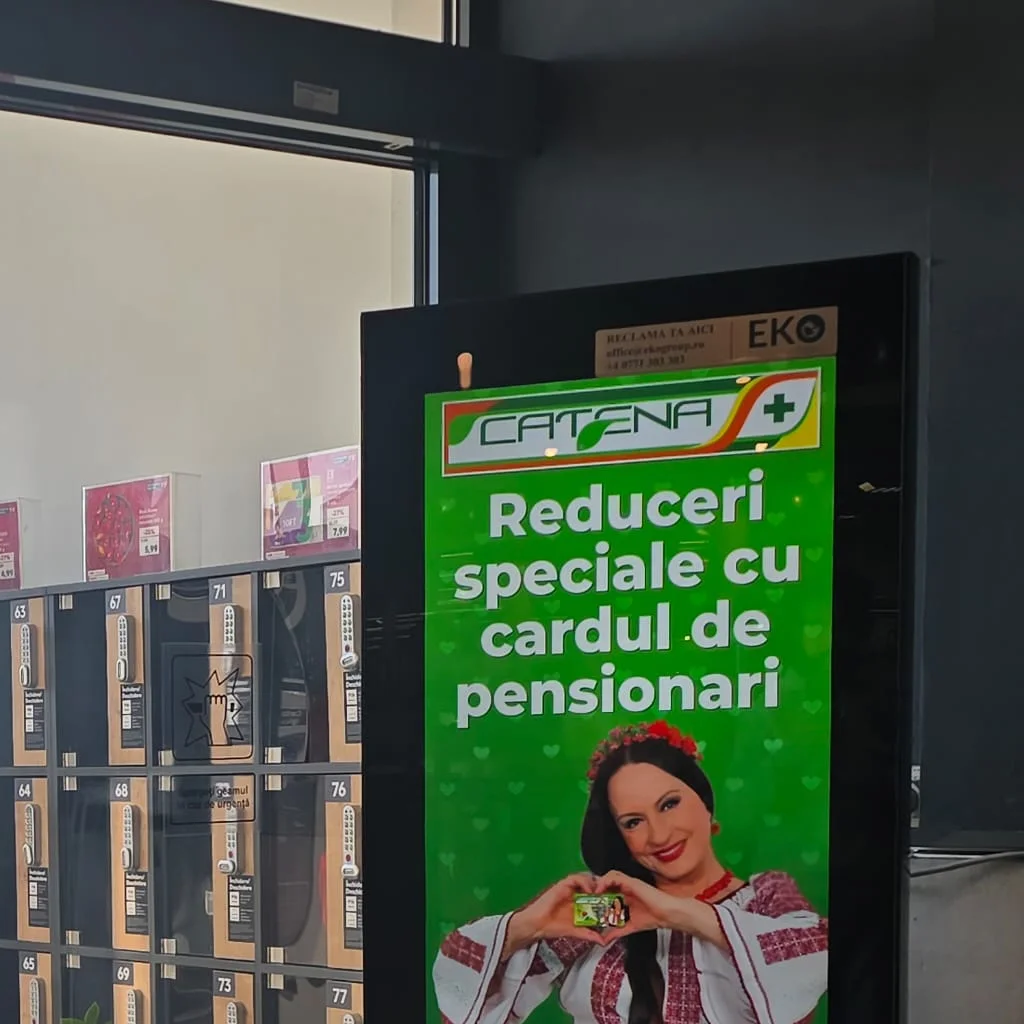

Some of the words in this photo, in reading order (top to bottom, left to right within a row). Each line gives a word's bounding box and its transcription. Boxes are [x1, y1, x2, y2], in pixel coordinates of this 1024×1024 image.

[607, 328, 665, 344] RECLAMA
[671, 327, 684, 337] TA
[688, 323, 714, 334] AICI
[749, 314, 826, 348] EKO
[480, 398, 712, 451] CATENA
[488, 467, 764, 538] Reduceri
[330, 571, 345, 587] 75
[454, 541, 705, 610] speciale
[724, 545, 800, 585] cu
[214, 584, 226, 600] 71
[110, 595, 121, 610] 67
[15, 605, 26, 618] 63
[480, 601, 670, 658] cardul
[691, 600, 771, 649] de
[457, 656, 780, 729] pensionari
[19, 784, 31, 797] 64
[115, 784, 128, 797] 68
[332, 782, 347, 797] 76
[23, 957, 34, 970] 65
[118, 966, 129, 981] 69
[218, 977, 232, 993] 73
[333, 988, 348, 1004] 77
